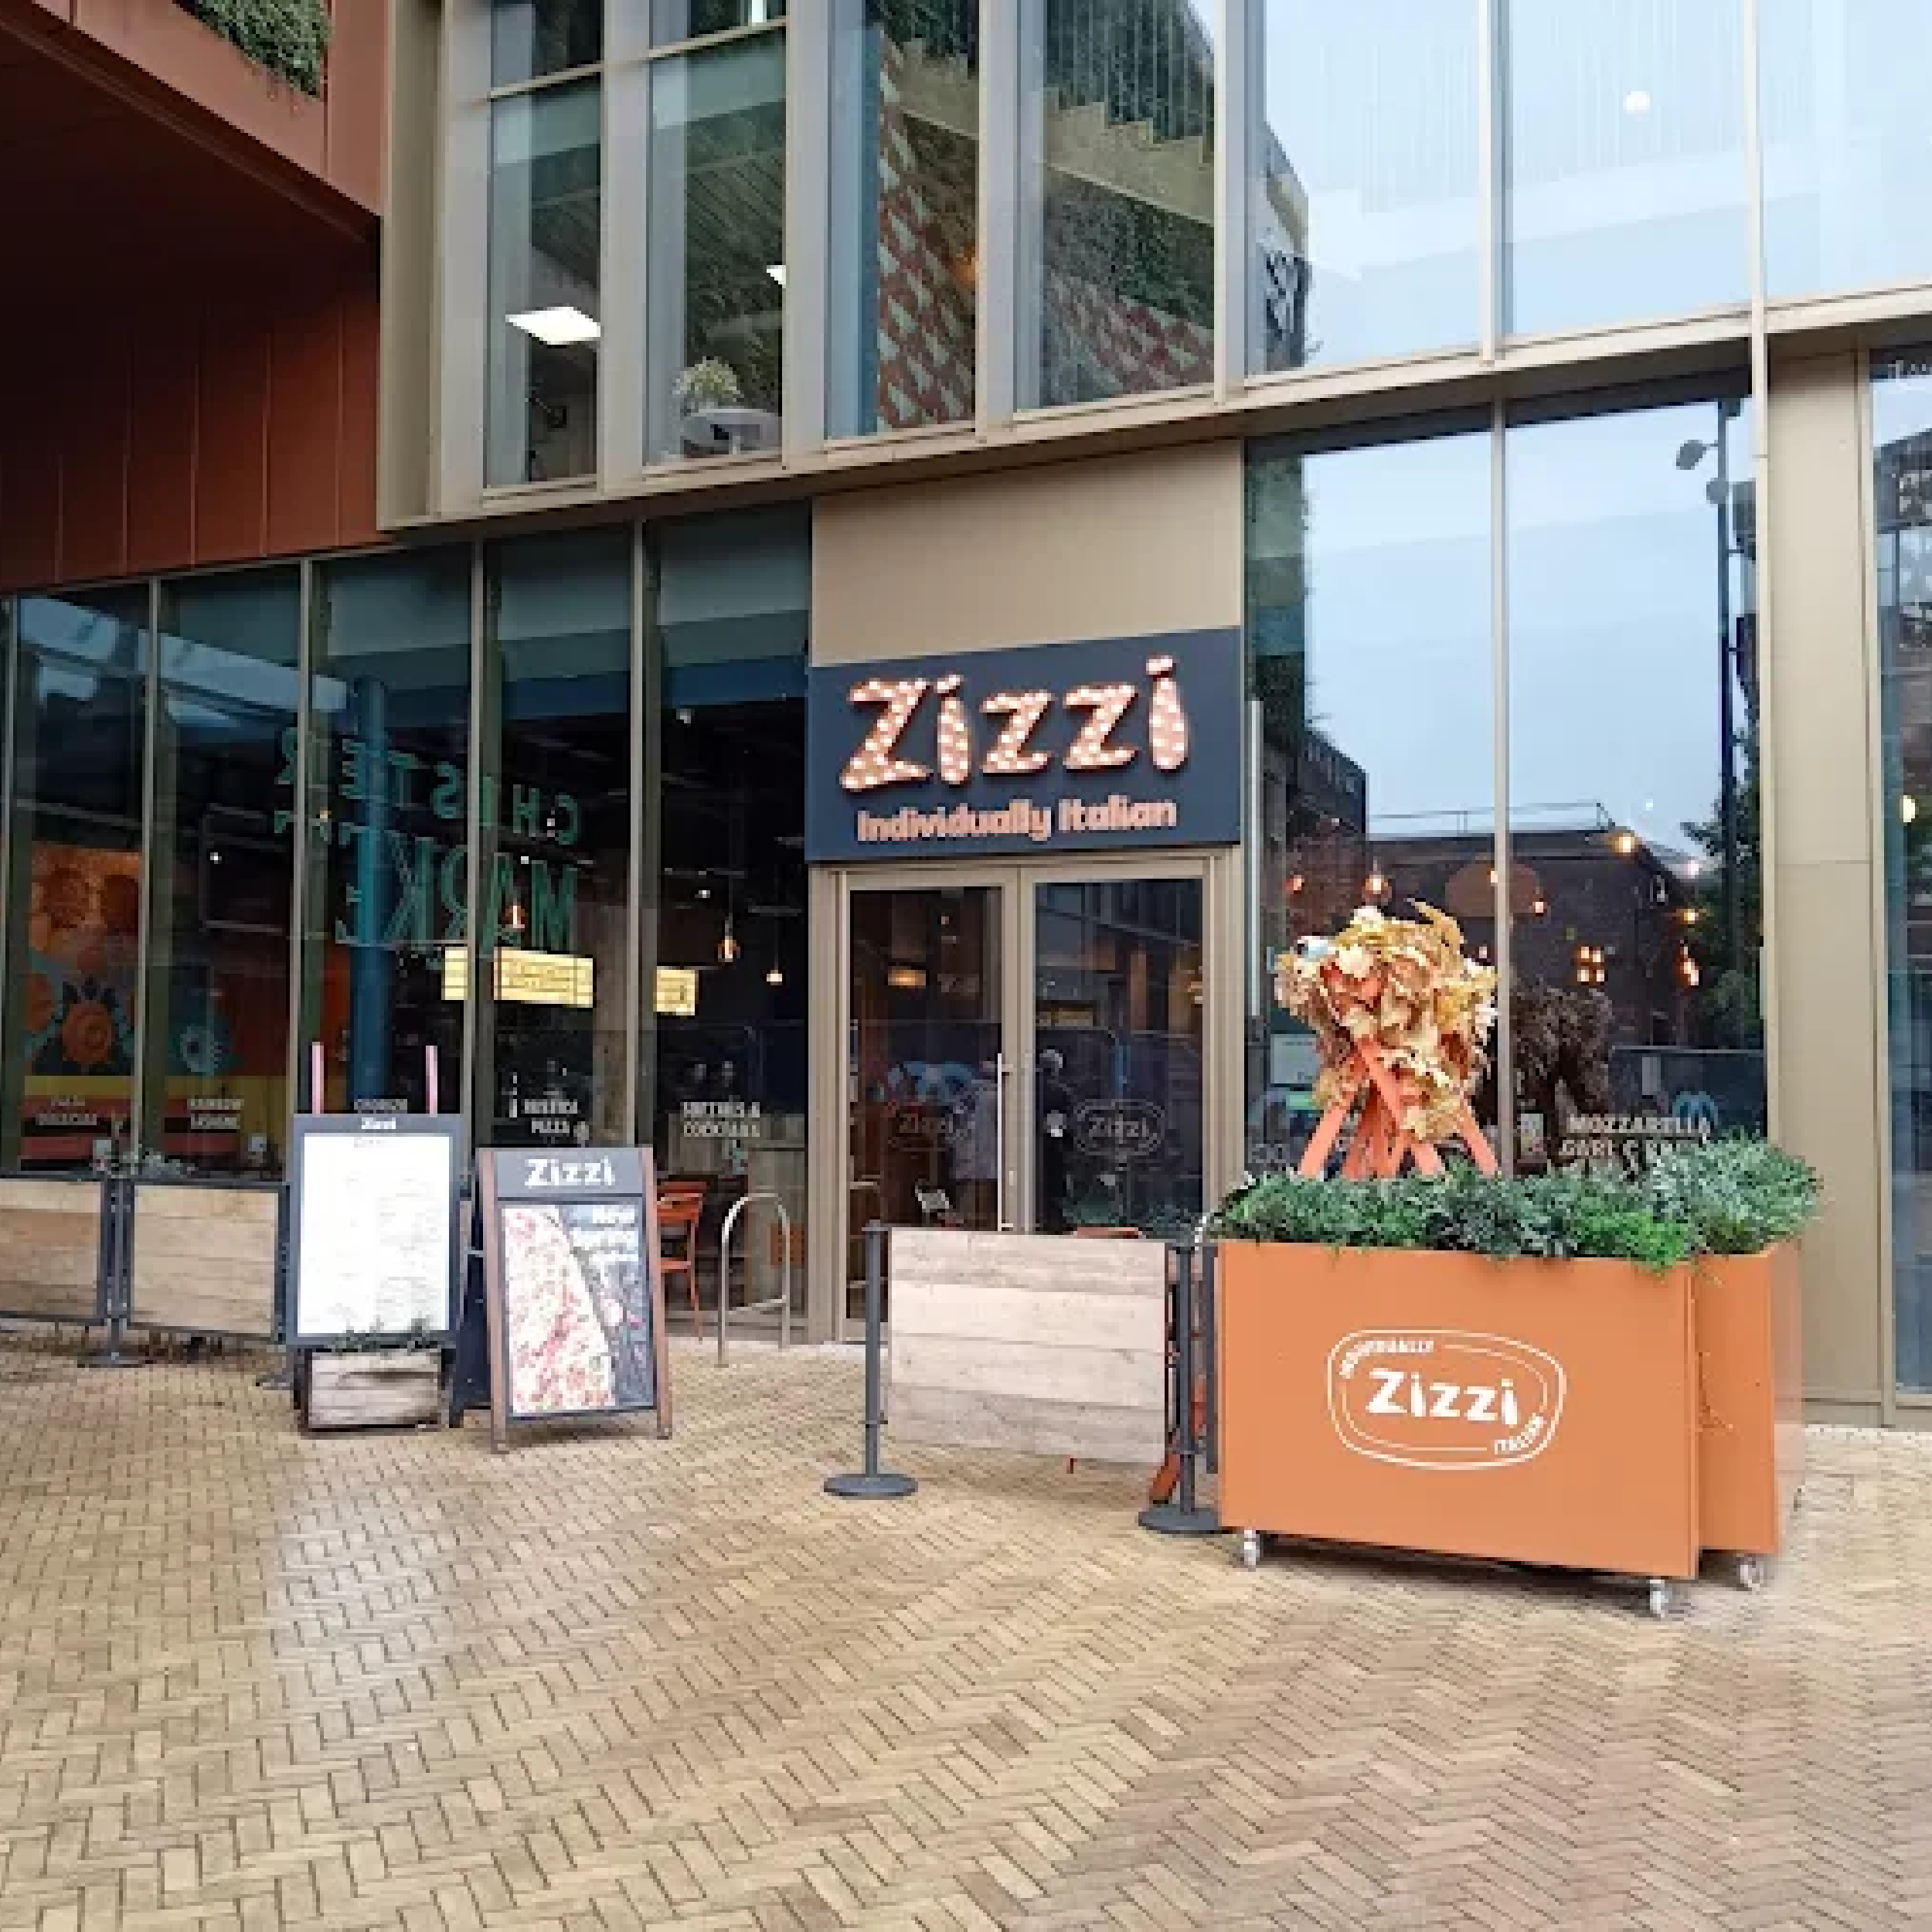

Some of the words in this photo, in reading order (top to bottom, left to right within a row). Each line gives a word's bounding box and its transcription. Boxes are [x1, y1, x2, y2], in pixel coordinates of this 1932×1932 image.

[841, 654, 1188, 791] Zizzi
[856, 798, 1052, 842] Individually
[1057, 794, 1178, 831] Italian
[524, 1155, 616, 1191] Zizzi
[1366, 1367, 1519, 1426] Zizzi
